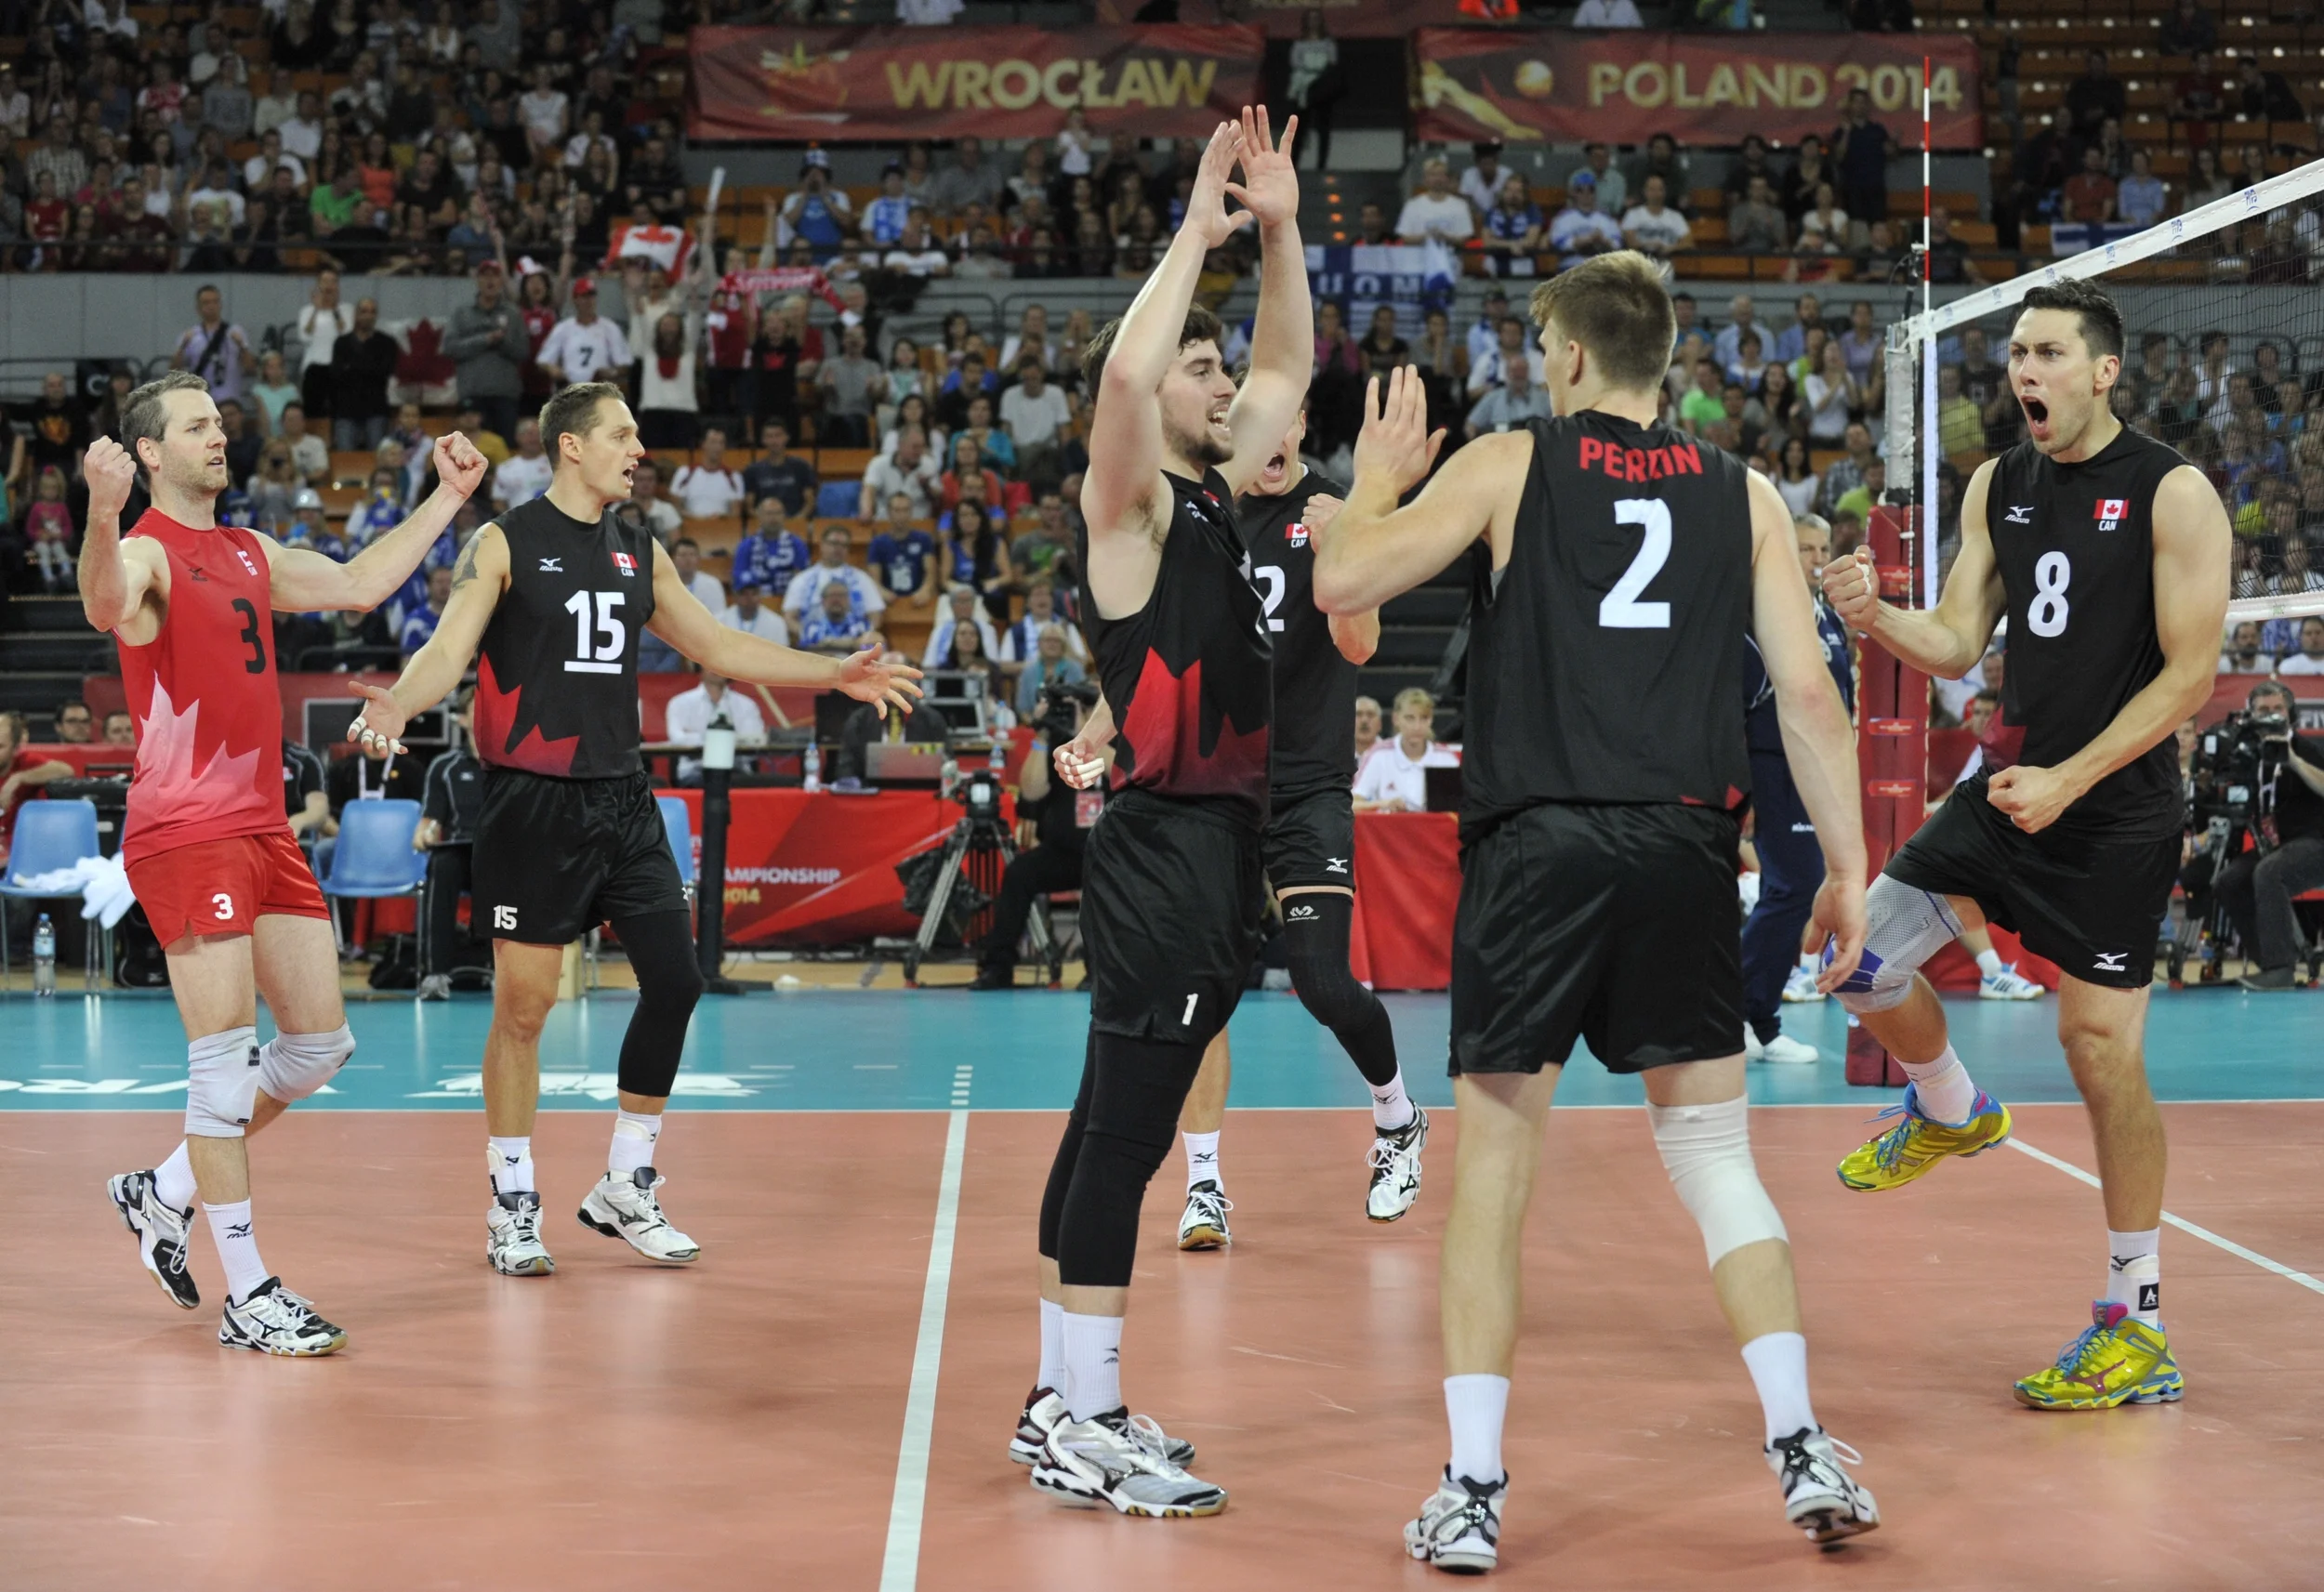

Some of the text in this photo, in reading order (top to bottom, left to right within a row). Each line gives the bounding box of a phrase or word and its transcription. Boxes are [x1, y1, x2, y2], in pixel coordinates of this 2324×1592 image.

[885, 59, 1217, 111] WROCŁAW
[1588, 60, 1963, 113] POLAND 2014
[2098, 520, 2118, 532] CAN
[1599, 497, 1672, 628] 2
[2027, 550, 2070, 638] 8
[231, 598, 267, 674] 3
[564, 589, 626, 662] 15
[693, 867, 840, 885] AMPIONSHIP
[723, 888, 760, 903] 014
[212, 893, 234, 920] 3
[494, 904, 518, 930] 15
[1182, 993, 1198, 1026] 1
